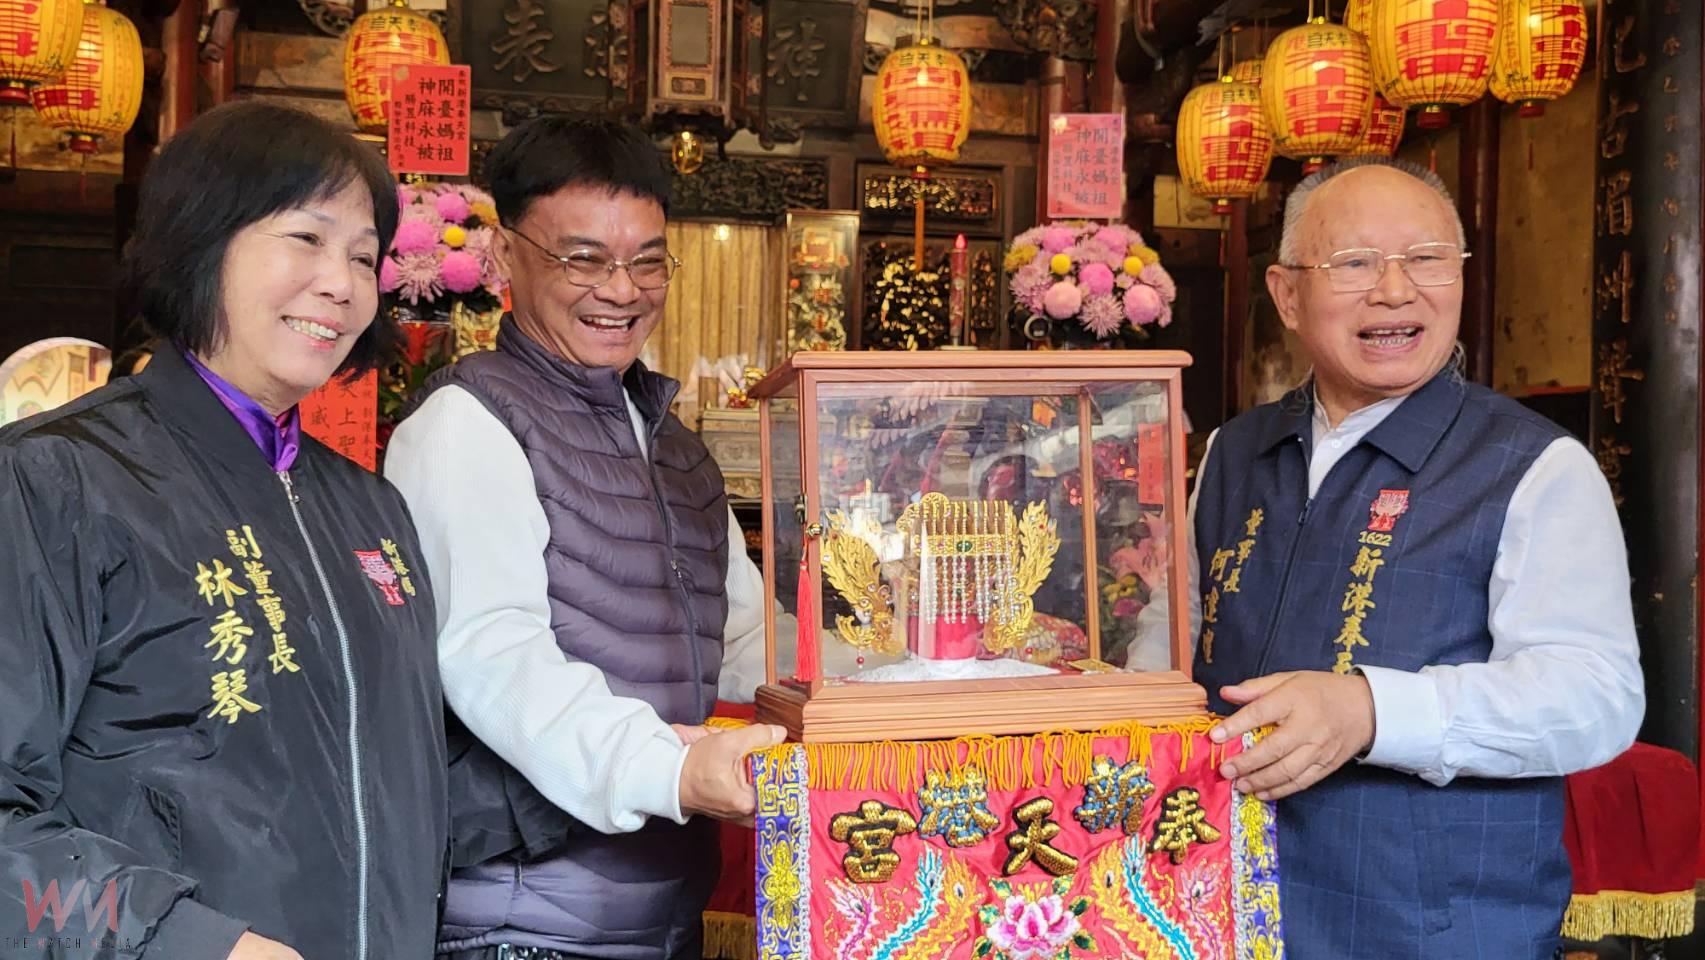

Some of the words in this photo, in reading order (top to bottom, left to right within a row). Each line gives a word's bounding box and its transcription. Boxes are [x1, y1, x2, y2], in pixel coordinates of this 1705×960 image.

[226, 525, 300, 675] 副董事長
[1358, 531, 1393, 547] 1622
[194, 558, 263, 725] 林秀琴
